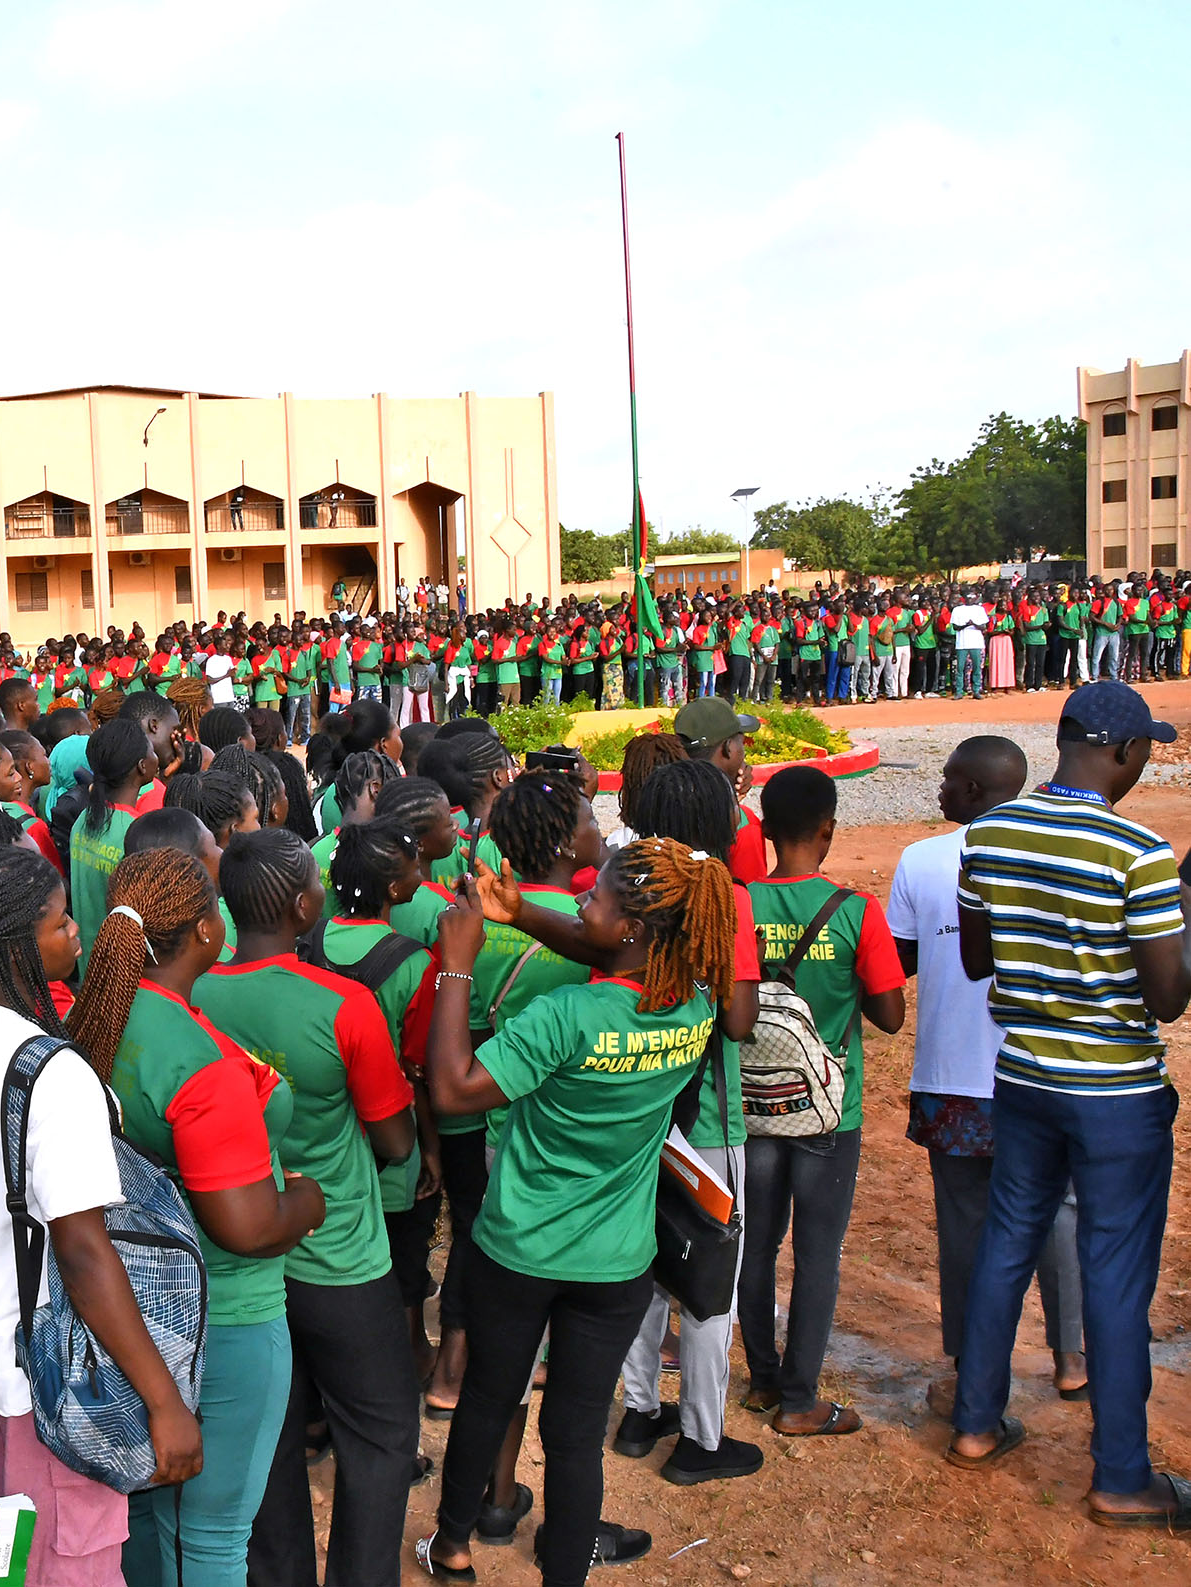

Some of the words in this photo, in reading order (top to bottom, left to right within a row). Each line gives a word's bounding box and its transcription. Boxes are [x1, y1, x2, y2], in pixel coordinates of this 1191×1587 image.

[945, 925, 960, 934] Ban
[765, 943, 786, 959] MA
[594, 1032, 619, 1054] JE
[627, 1017, 714, 1054] M'ENGAGE
[580, 1056, 636, 1073] POUR
[637, 1053, 662, 1071] MA
[753, 1103, 789, 1115] LOVE
